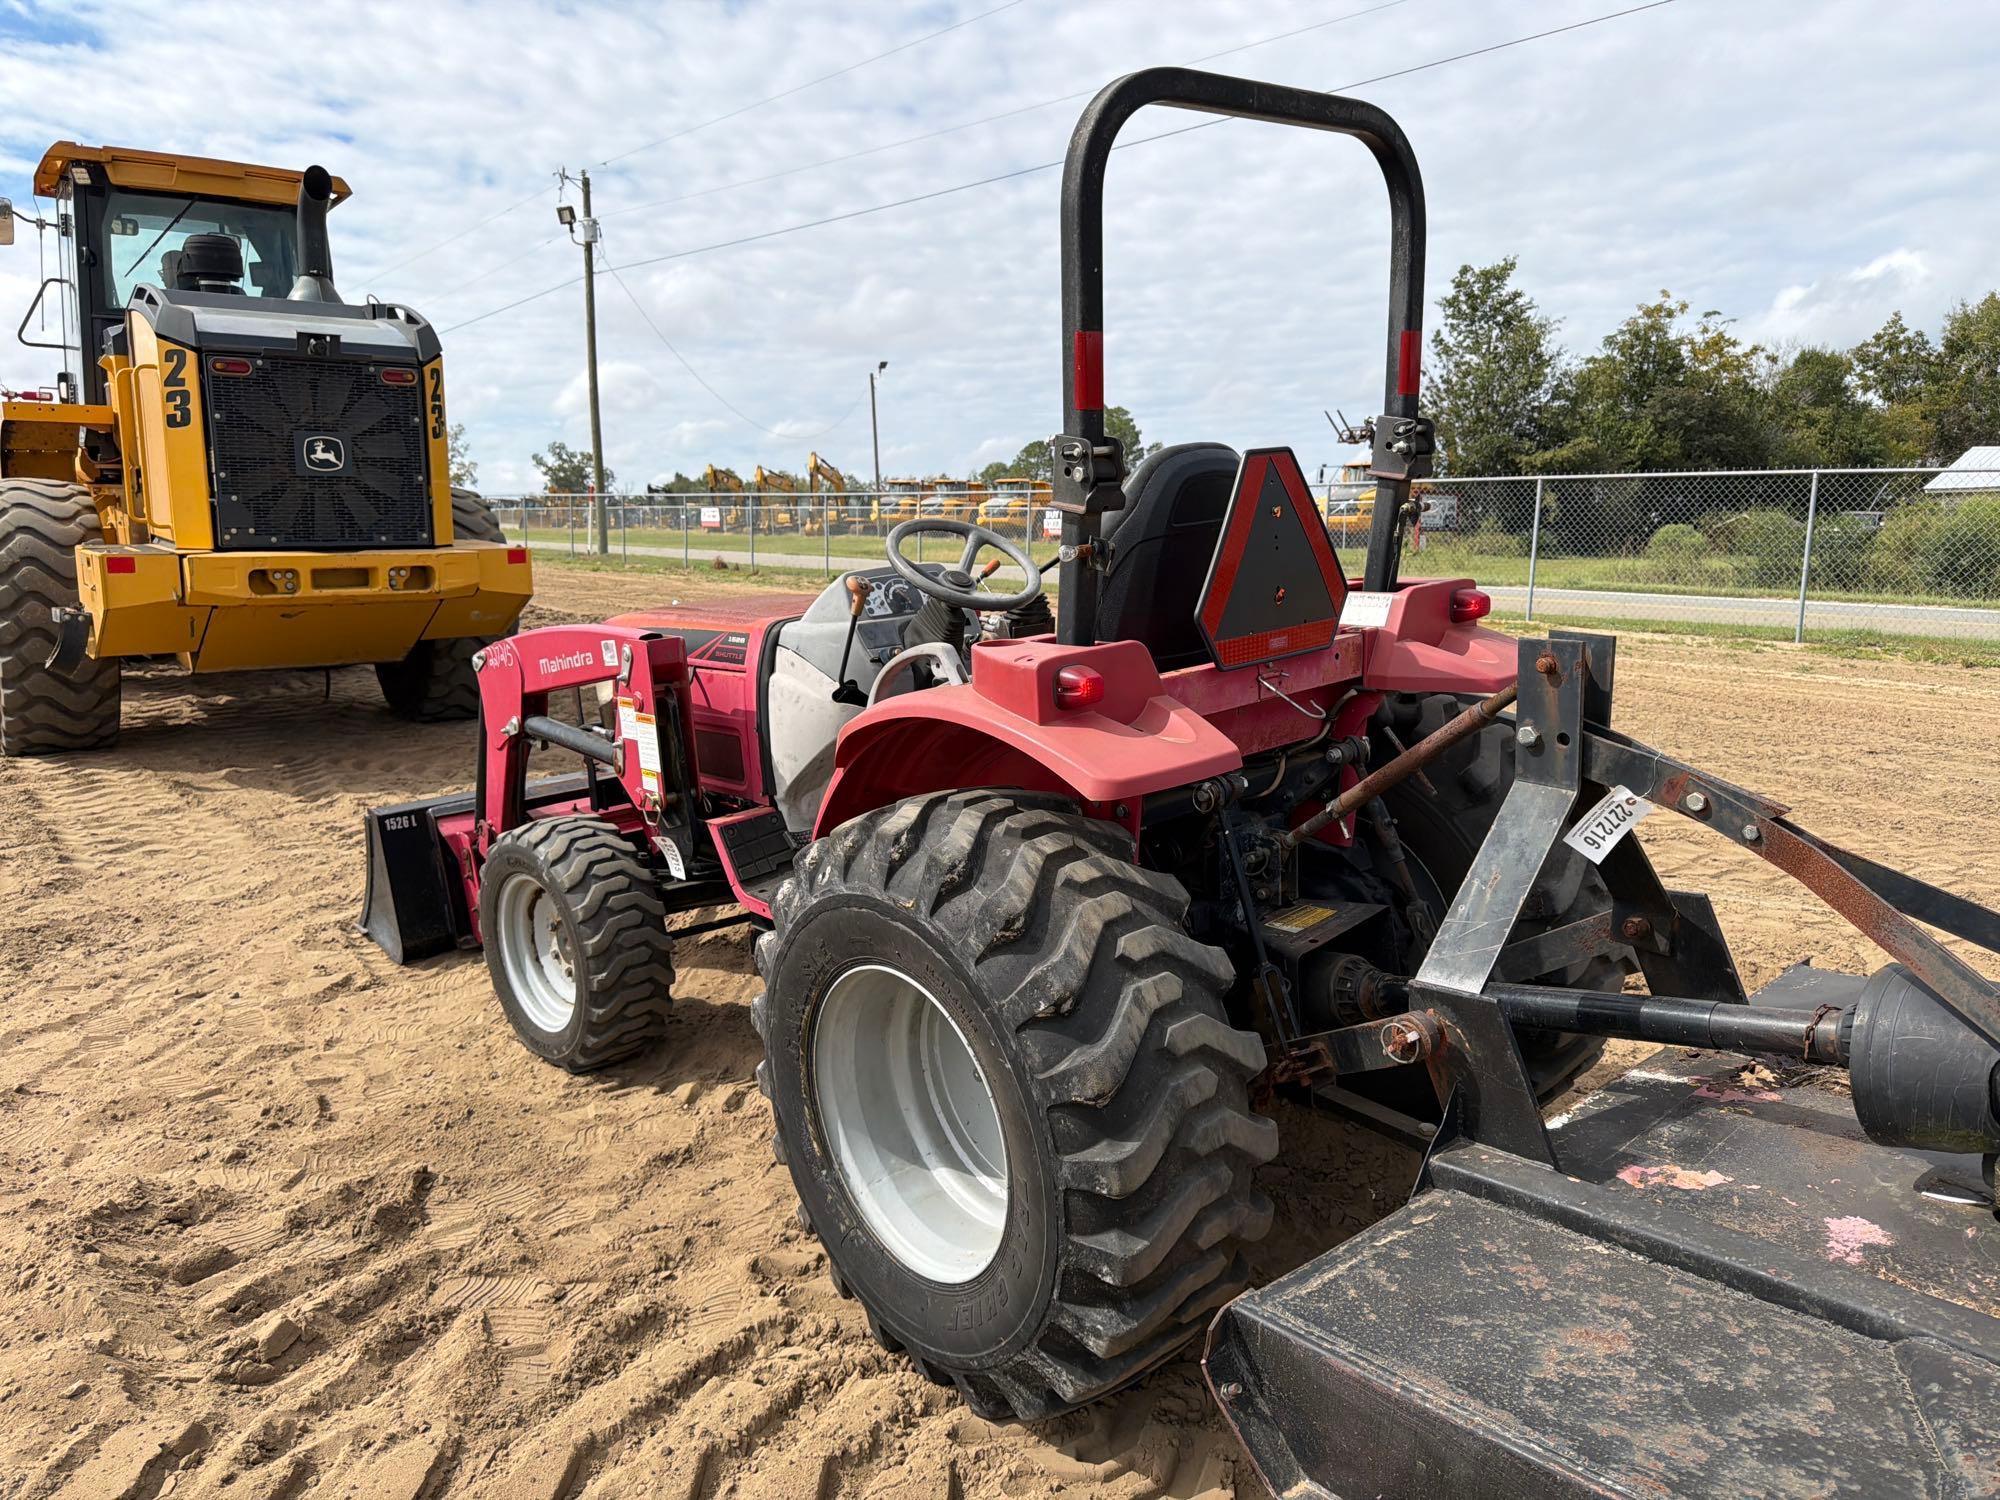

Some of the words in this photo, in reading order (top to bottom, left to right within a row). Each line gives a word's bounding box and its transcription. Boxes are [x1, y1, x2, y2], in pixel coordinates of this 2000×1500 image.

[539, 650, 593, 675] Mahindra
[715, 651, 744, 660] SHUTTLE
[384, 815, 410, 831] 1526
[411, 815, 417, 827] L
[1583, 803, 1633, 849] 227216
